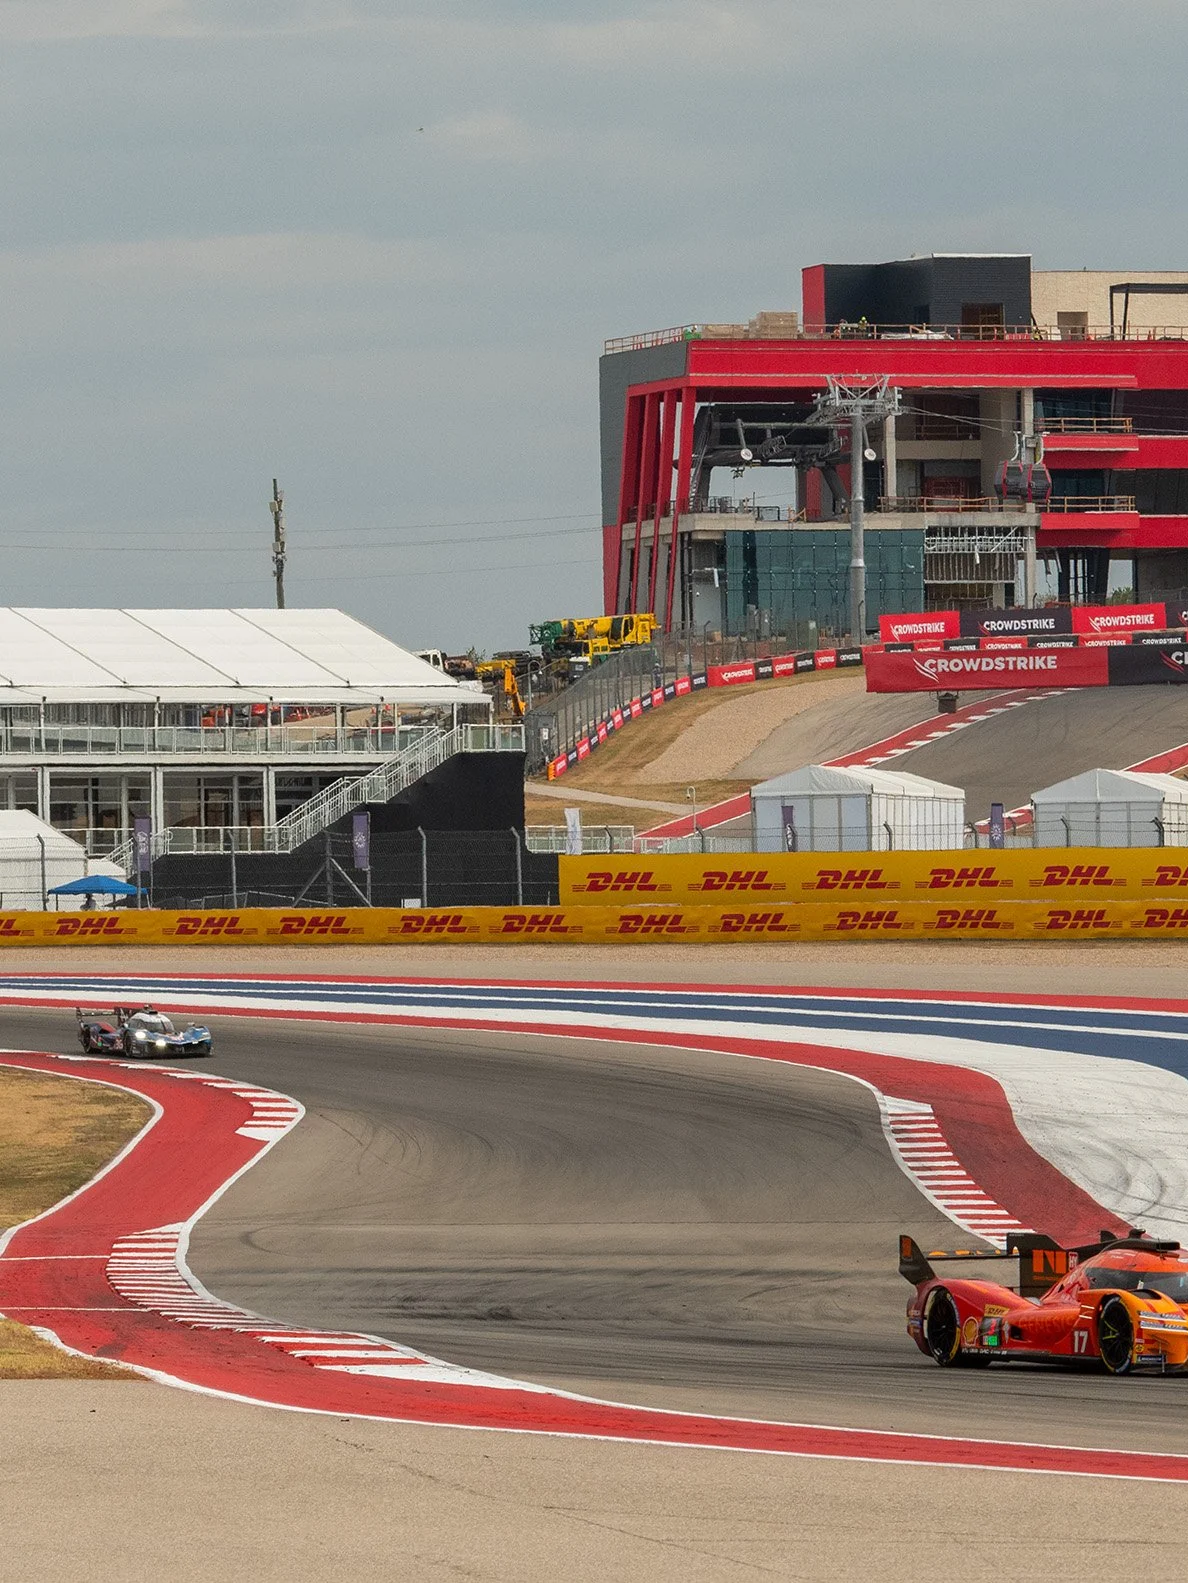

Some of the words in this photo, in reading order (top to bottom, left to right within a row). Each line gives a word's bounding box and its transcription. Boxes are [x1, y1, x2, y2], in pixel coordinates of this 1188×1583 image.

[893, 622, 945, 635] CROWDSTRIKE
[983, 618, 1056, 631] CROWDSTRIKE
[1094, 614, 1155, 627] CROWDSTRIKE
[923, 655, 1058, 673] CROWDSTRIKE
[586, 871, 658, 892] DHL
[700, 870, 773, 891] DHL
[815, 869, 888, 890] DHL
[929, 867, 1000, 889] DHL
[1043, 865, 1115, 887] DHL
[55, 917, 124, 936] DHL
[175, 916, 244, 936] DHL
[278, 916, 351, 935] DHL
[400, 915, 467, 934] DHL
[501, 915, 570, 934] DHL
[618, 914, 688, 934] DHL
[718, 913, 788, 933] DHL
[835, 911, 902, 931] DHL
[934, 909, 1001, 930] DHL
[1045, 910, 1112, 930] DHL
[1073, 1330, 1089, 1354] 17
